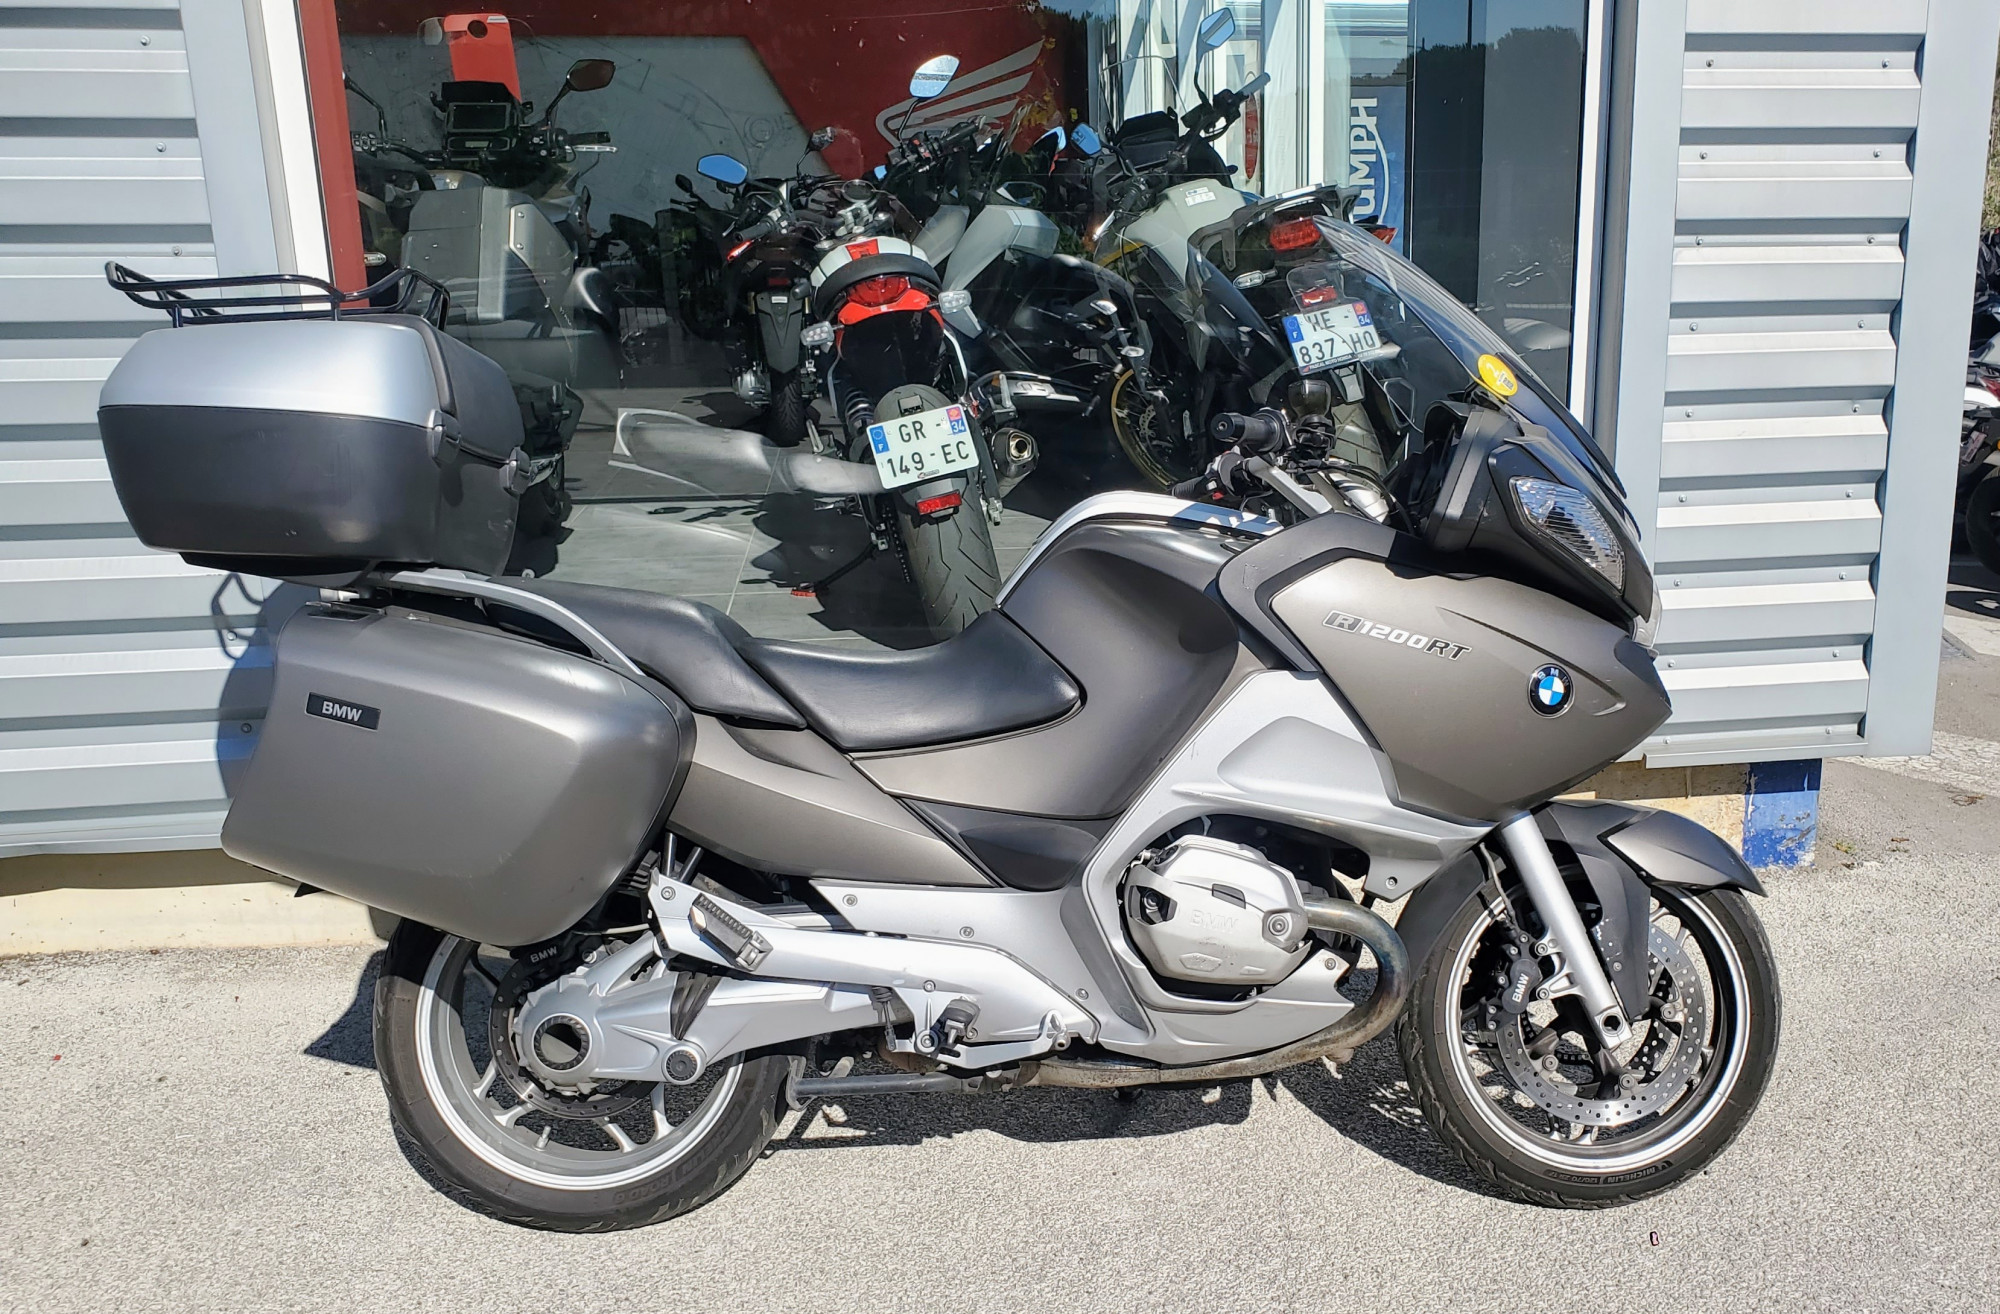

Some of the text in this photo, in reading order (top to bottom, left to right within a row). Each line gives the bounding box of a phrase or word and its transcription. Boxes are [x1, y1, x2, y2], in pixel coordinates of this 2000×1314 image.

[1358, 315, 1371, 325] 34
[898, 420, 927, 443] GR
[951, 421, 965, 433] 34
[878, 443, 884, 451] F
[1537, 667, 1570, 687] BMW
[321, 700, 363, 722] BMW
[1190, 909, 1241, 933] BMW
[530, 946, 558, 963] BMW
[1511, 972, 1529, 1003] BMW
[680, 1105, 742, 1178] MICHELIN
[1571, 1175, 1599, 1184] 120/70
[1607, 1166, 1656, 1184] MICHELIN
[630, 1174, 670, 1200] ROAD
